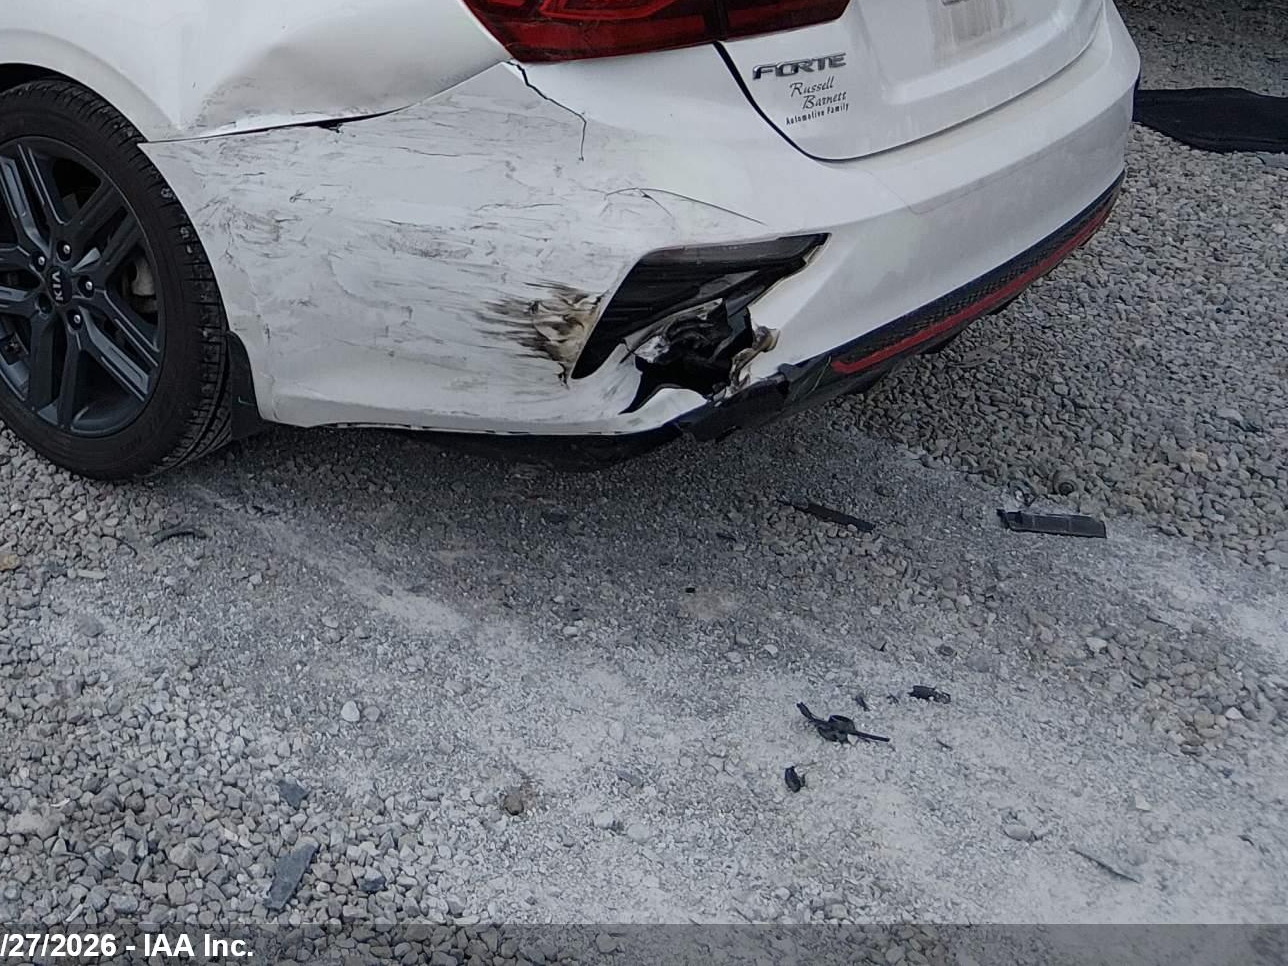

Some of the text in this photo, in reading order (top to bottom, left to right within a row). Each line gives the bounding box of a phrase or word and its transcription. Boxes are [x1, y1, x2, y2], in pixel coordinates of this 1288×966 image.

[752, 52, 847, 81] FORTE
[789, 75, 835, 98] Russell
[802, 91, 847, 110] Barnett
[785, 102, 849, 126] Automotive Family
[52, 271, 64, 301] KIA
